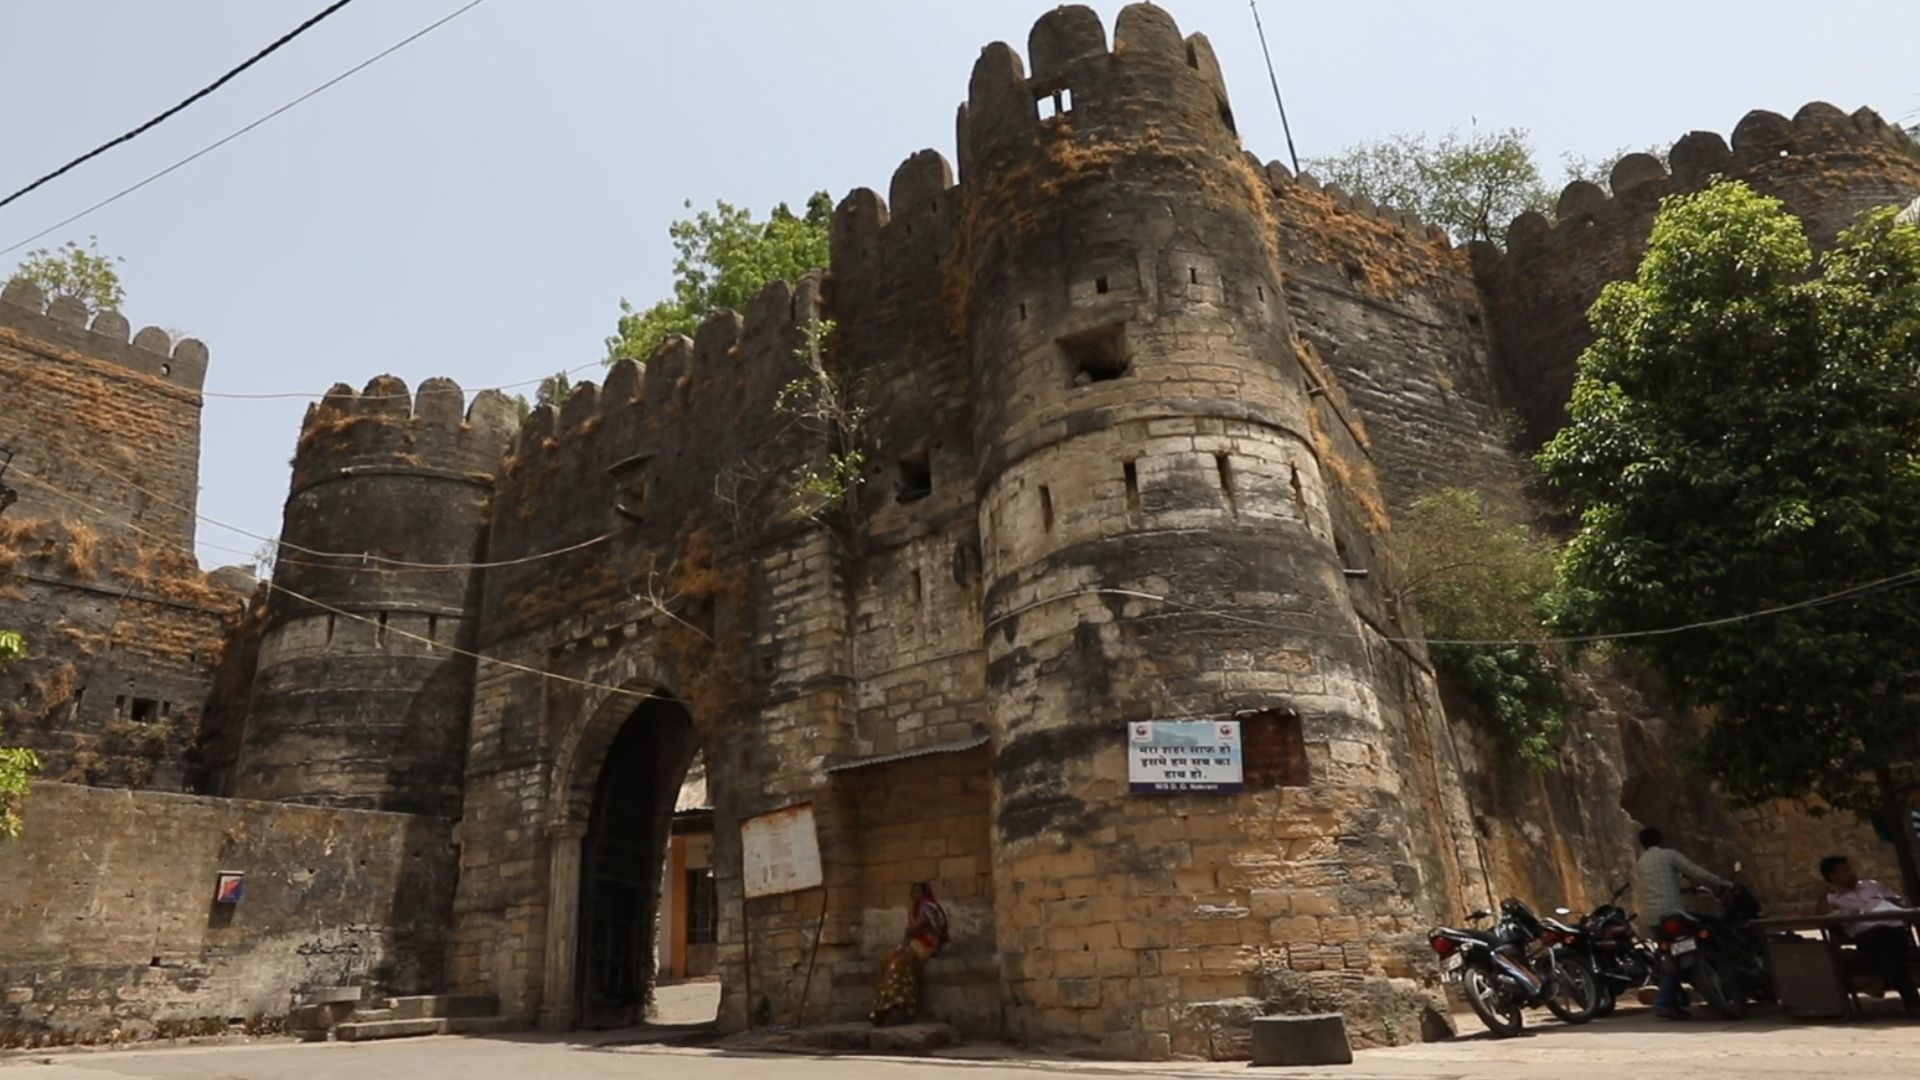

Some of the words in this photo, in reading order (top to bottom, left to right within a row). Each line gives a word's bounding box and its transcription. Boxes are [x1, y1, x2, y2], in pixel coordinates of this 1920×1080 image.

[1162, 745, 1184, 755] शहर
[1218, 742, 1231, 755] हो
[1170, 757, 1187, 767] हम
[1190, 757, 1211, 766] सब
[1214, 757, 1231, 766] का
